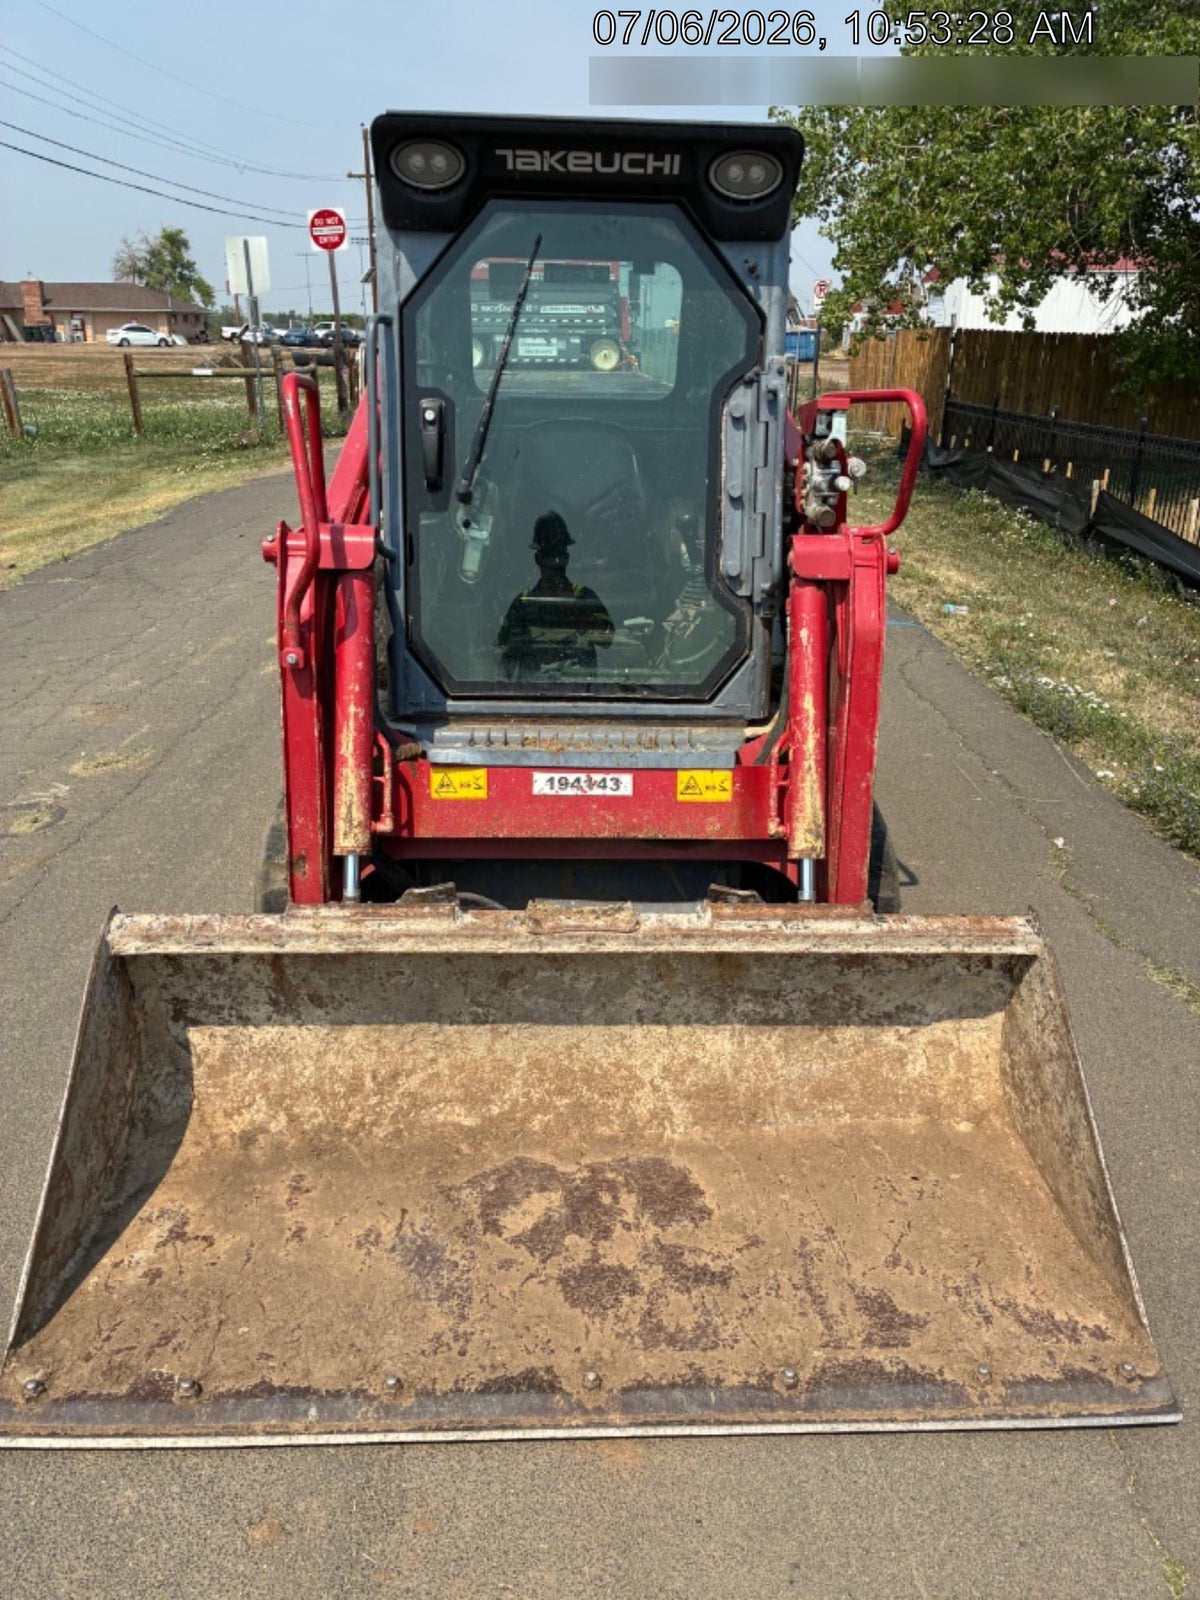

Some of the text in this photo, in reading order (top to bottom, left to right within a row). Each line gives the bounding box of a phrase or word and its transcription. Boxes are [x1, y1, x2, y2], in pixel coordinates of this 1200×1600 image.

[314, 216, 339, 226] DO NOT
[319, 235, 340, 244] ENTER
